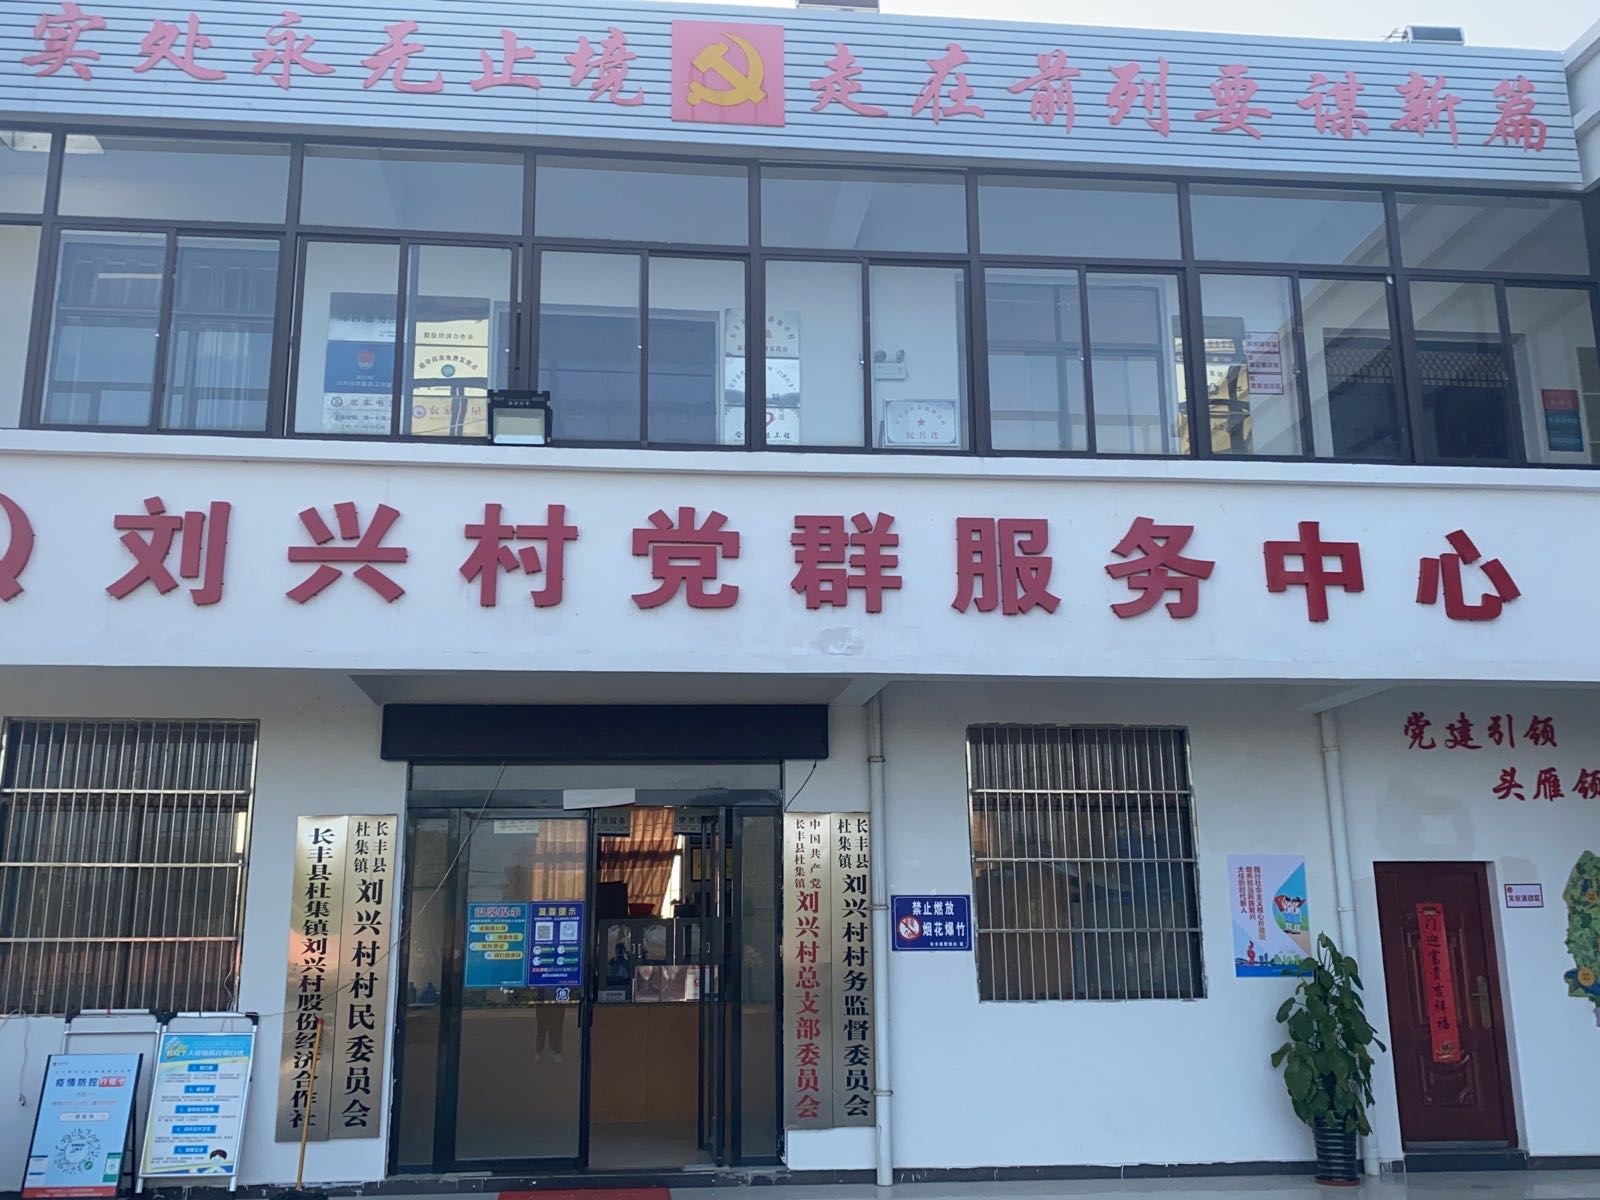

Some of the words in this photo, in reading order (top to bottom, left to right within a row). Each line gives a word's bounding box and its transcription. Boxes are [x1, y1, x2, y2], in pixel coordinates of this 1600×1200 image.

[22, 2, 644, 106] 实处永无止境
[810, 42, 1547, 152] 走在前列要谋新篇
[105, 497, 1521, 622] 刘兴村党群服务中心
[1403, 711, 1558, 750] 党建引领
[354, 821, 370, 873] 杜集镇
[373, 821, 388, 873] 长丰县
[794, 819, 805, 889] 长丰县杜集镇
[809, 819, 821, 889] 中国共产党
[838, 818, 852, 869] 杜集镇
[855, 818, 868, 869] 长丰县
[912, 901, 954, 916] 禁止燃放
[922, 921, 965, 937] 烟花爆竹
[289, 827, 335, 1128] 长丰县杜集镇刘兴村股份经济合作社
[341, 879, 384, 1128] 刘兴村村民委员会
[795, 891, 821, 1119] 刘兴村总支部委员会
[842, 874, 871, 1117] 刘兴村村务监督委员会
